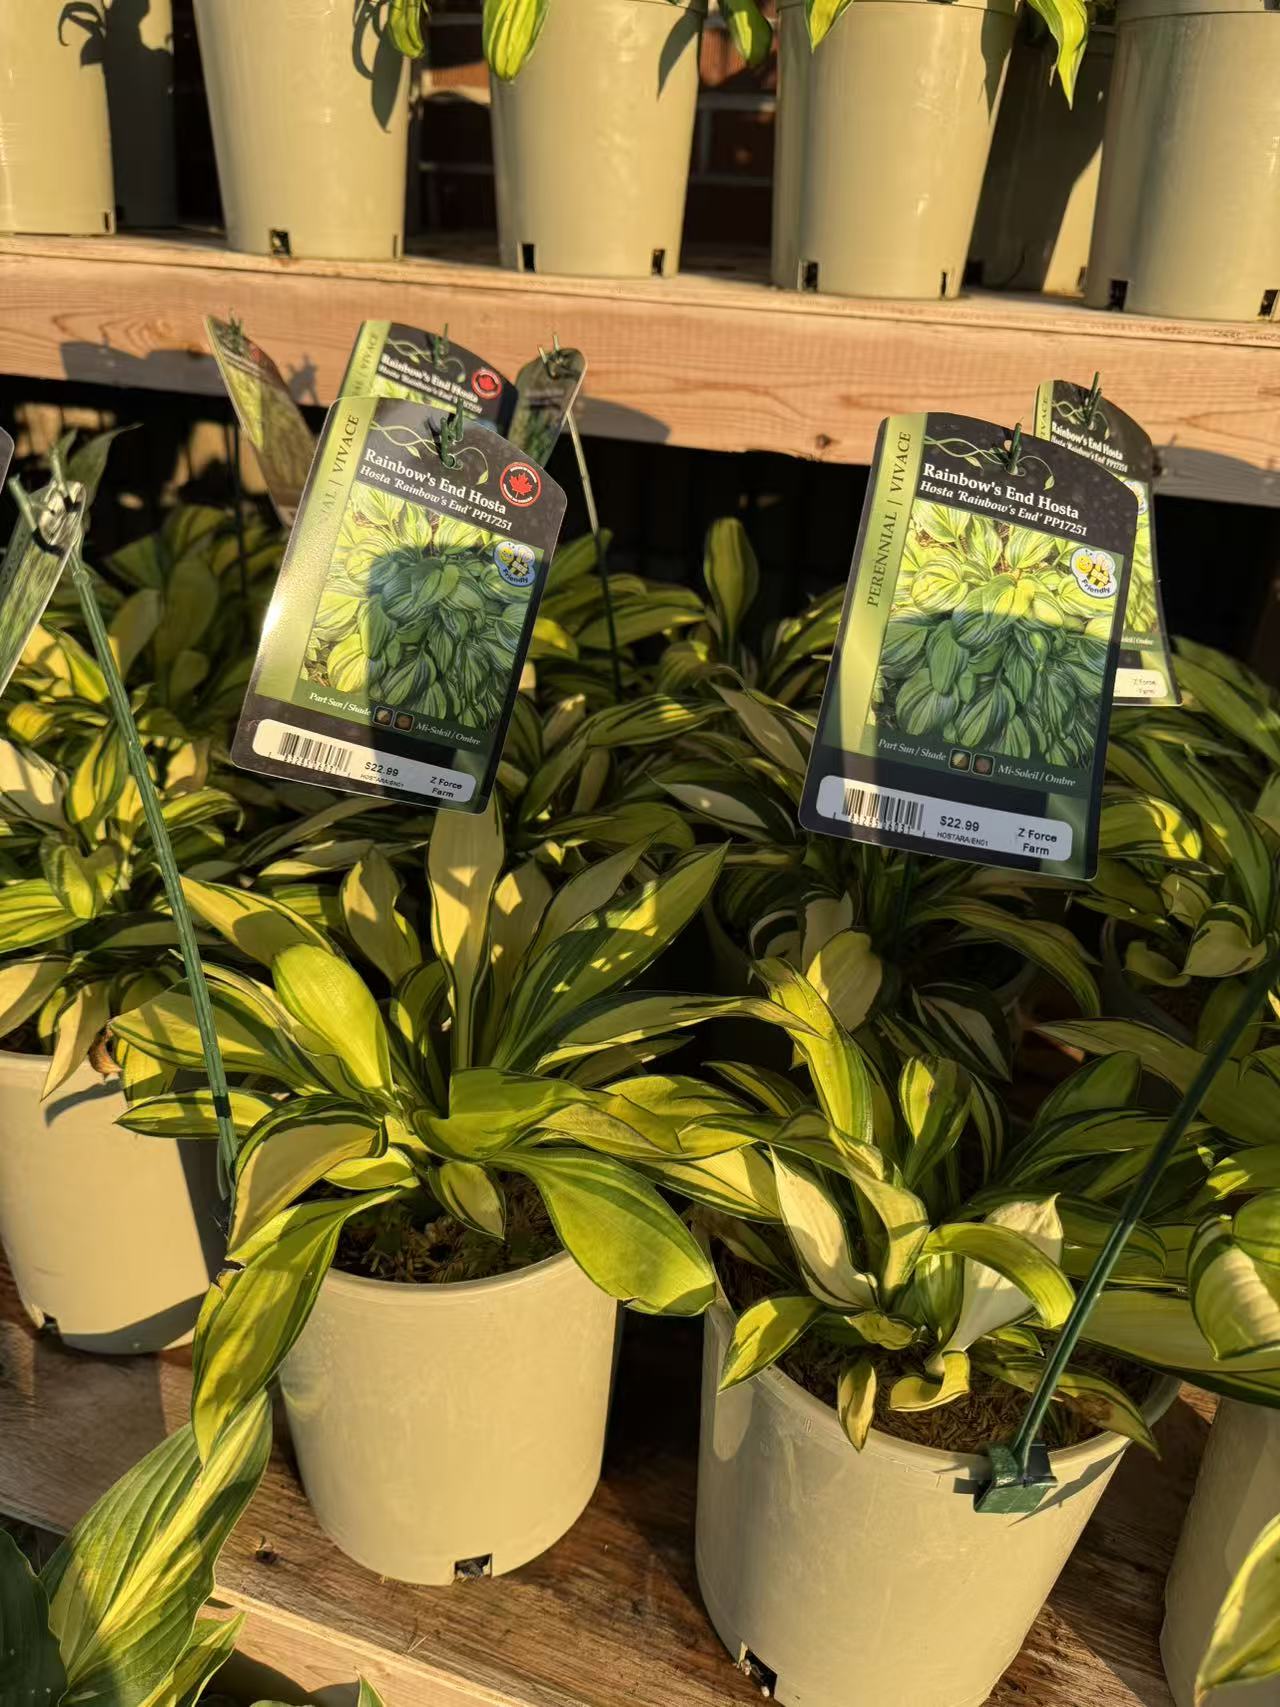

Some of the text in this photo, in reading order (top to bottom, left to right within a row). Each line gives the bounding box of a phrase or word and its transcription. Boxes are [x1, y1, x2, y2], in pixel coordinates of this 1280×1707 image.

[430, 374, 452, 391] End
[332, 414, 360, 474] VIVACE
[1051, 421, 1124, 461] Rainbow's End Hosta
[364, 448, 437, 487] Rainbow's
[439, 477, 465, 500] End
[468, 488, 507, 515] Hosta
[922, 462, 1080, 520] Rainbow's End Hosta
[360, 465, 391, 485] Hosta
[471, 508, 513, 531] PP17251
[920, 480, 954, 498] Hosta
[1043, 515, 1088, 537] PP17251
[867, 511, 898, 608] PERENNIAL
[890, 431, 912, 493] VIVACE
[1082, 578, 1111, 594] Friendly
[309, 692, 328, 705] Part
[328, 698, 343, 710] Sun
[348, 703, 372, 716] Shade
[455, 733, 481, 746] Ombre
[878, 738, 899, 751] Part
[898, 744, 915, 755] Sun
[920, 748, 947, 762] Shade
[364, 761, 399, 777] $22.99
[998, 765, 1040, 780] Mi-Soleil
[1045, 774, 1076, 787] Ombre
[430, 776, 463, 790] Z Force
[431, 787, 454, 798] Farm
[939, 815, 980, 832] $22.99
[1018, 827, 1058, 843] Z Force
[1022, 842, 1050, 856] Farm
